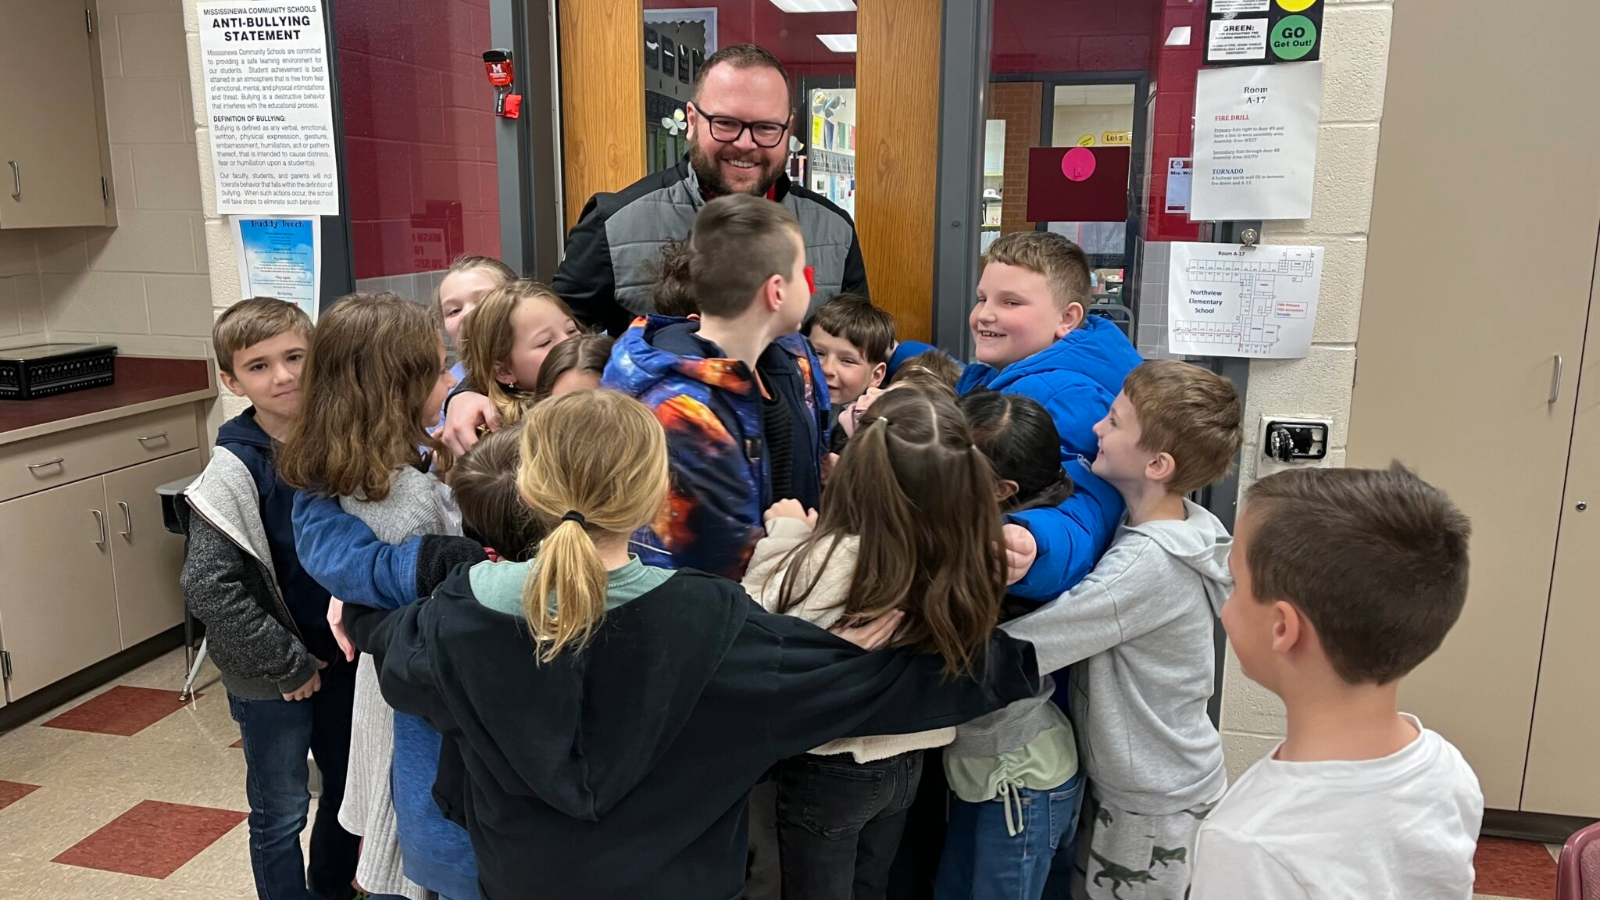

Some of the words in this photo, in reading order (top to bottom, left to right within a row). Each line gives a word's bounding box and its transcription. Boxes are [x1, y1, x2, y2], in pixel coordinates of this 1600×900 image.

[213, 16, 310, 28] ANTI-BULLYING
[225, 30, 300, 41] STATEMENT
[1282, 27, 1305, 39] GO
[492, 64, 502, 73] M
